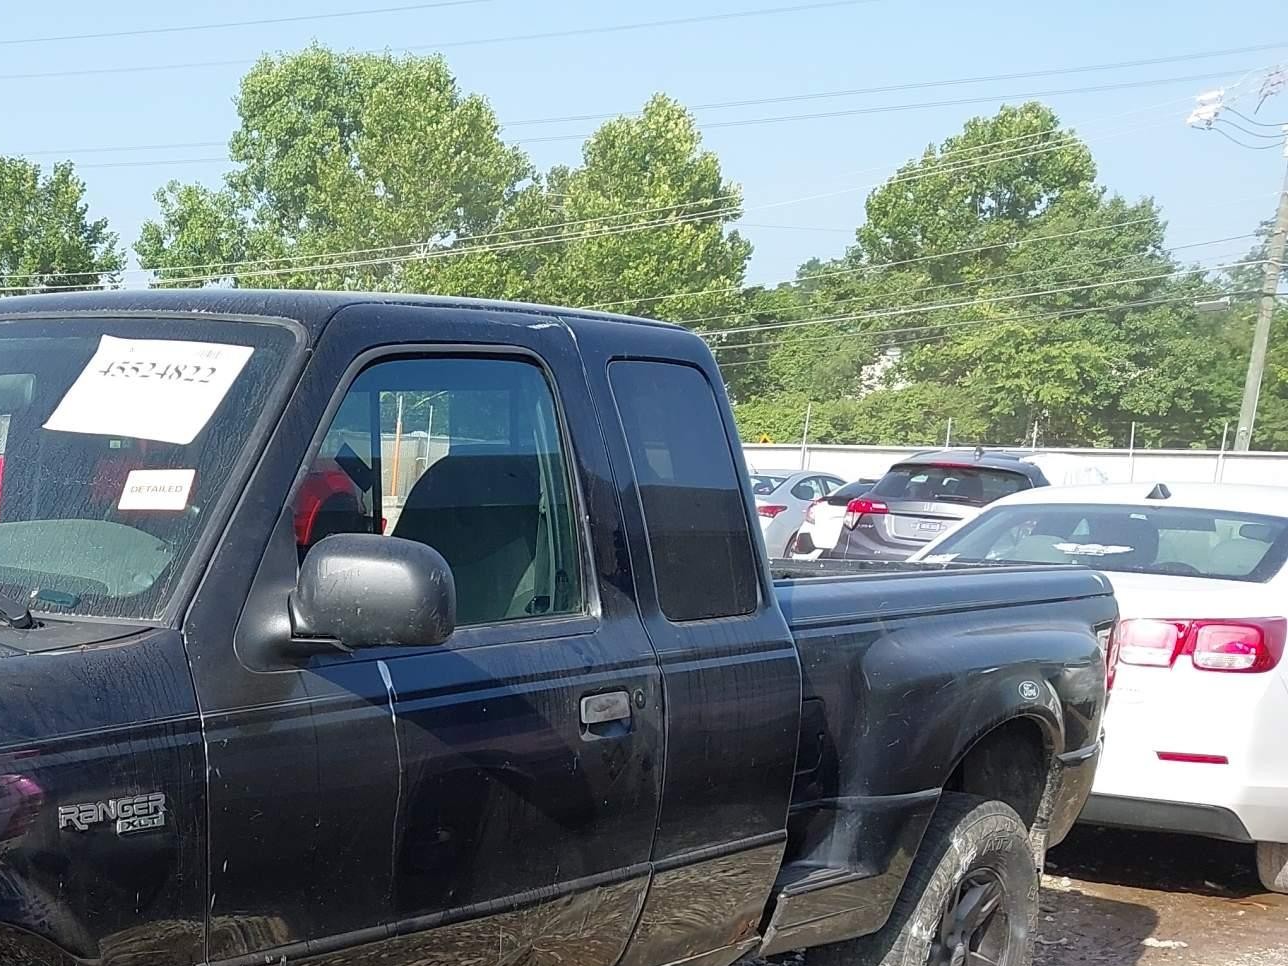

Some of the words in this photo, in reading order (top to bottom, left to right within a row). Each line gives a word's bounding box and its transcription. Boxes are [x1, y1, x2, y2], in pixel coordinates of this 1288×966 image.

[98, 361, 217, 384] 45524822
[130, 484, 184, 494] DETAILED
[58, 792, 167, 831] RANGER
